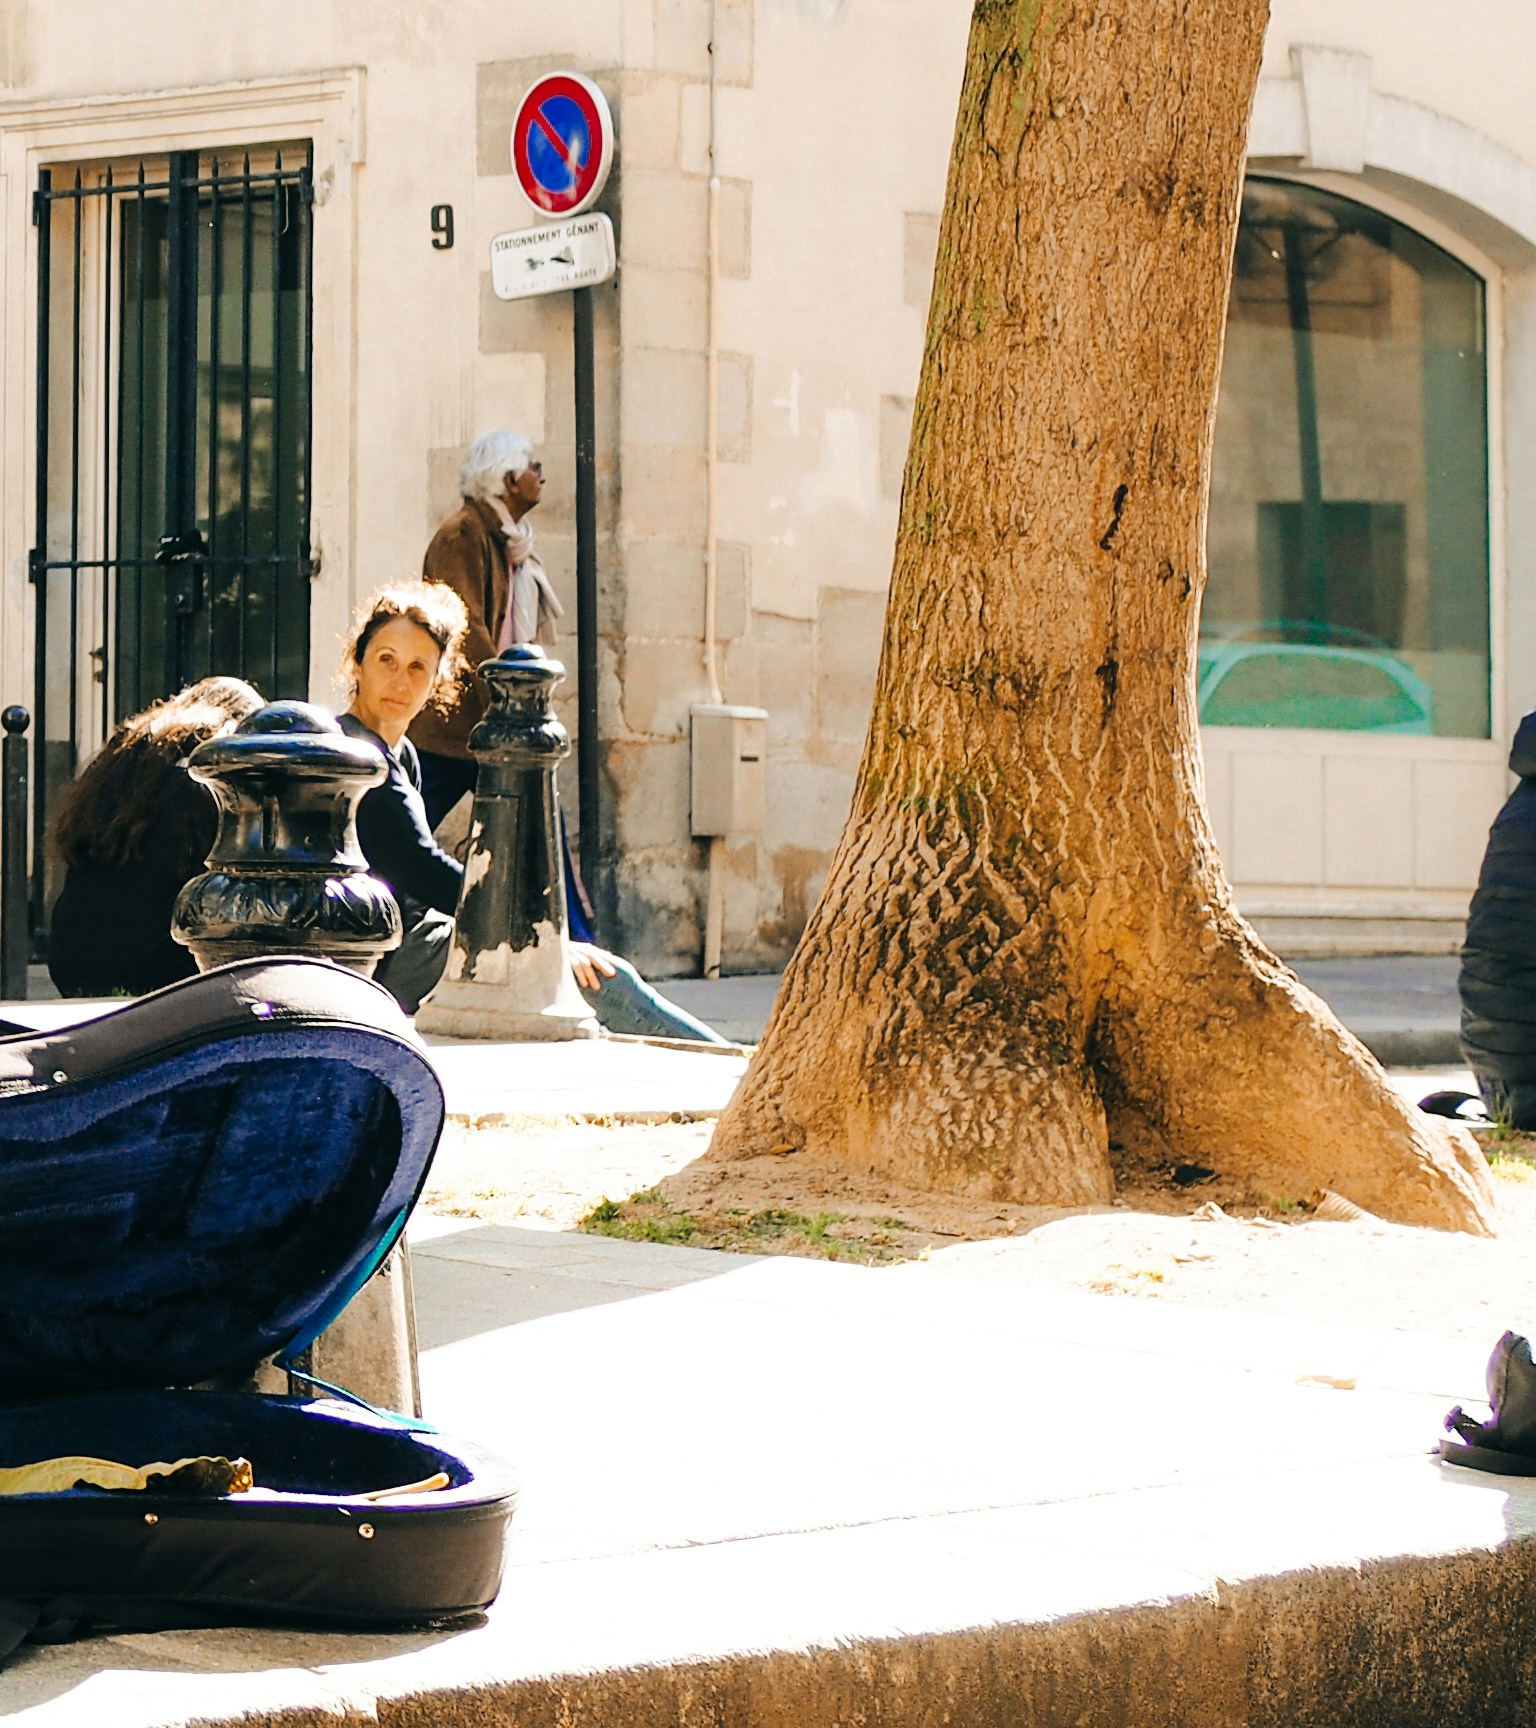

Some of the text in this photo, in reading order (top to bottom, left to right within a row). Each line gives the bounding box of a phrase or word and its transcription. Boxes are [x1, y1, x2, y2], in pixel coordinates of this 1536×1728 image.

[430, 204, 454, 250] 9
[494, 223, 599, 252] STATIONNEMENT GÊNANT
